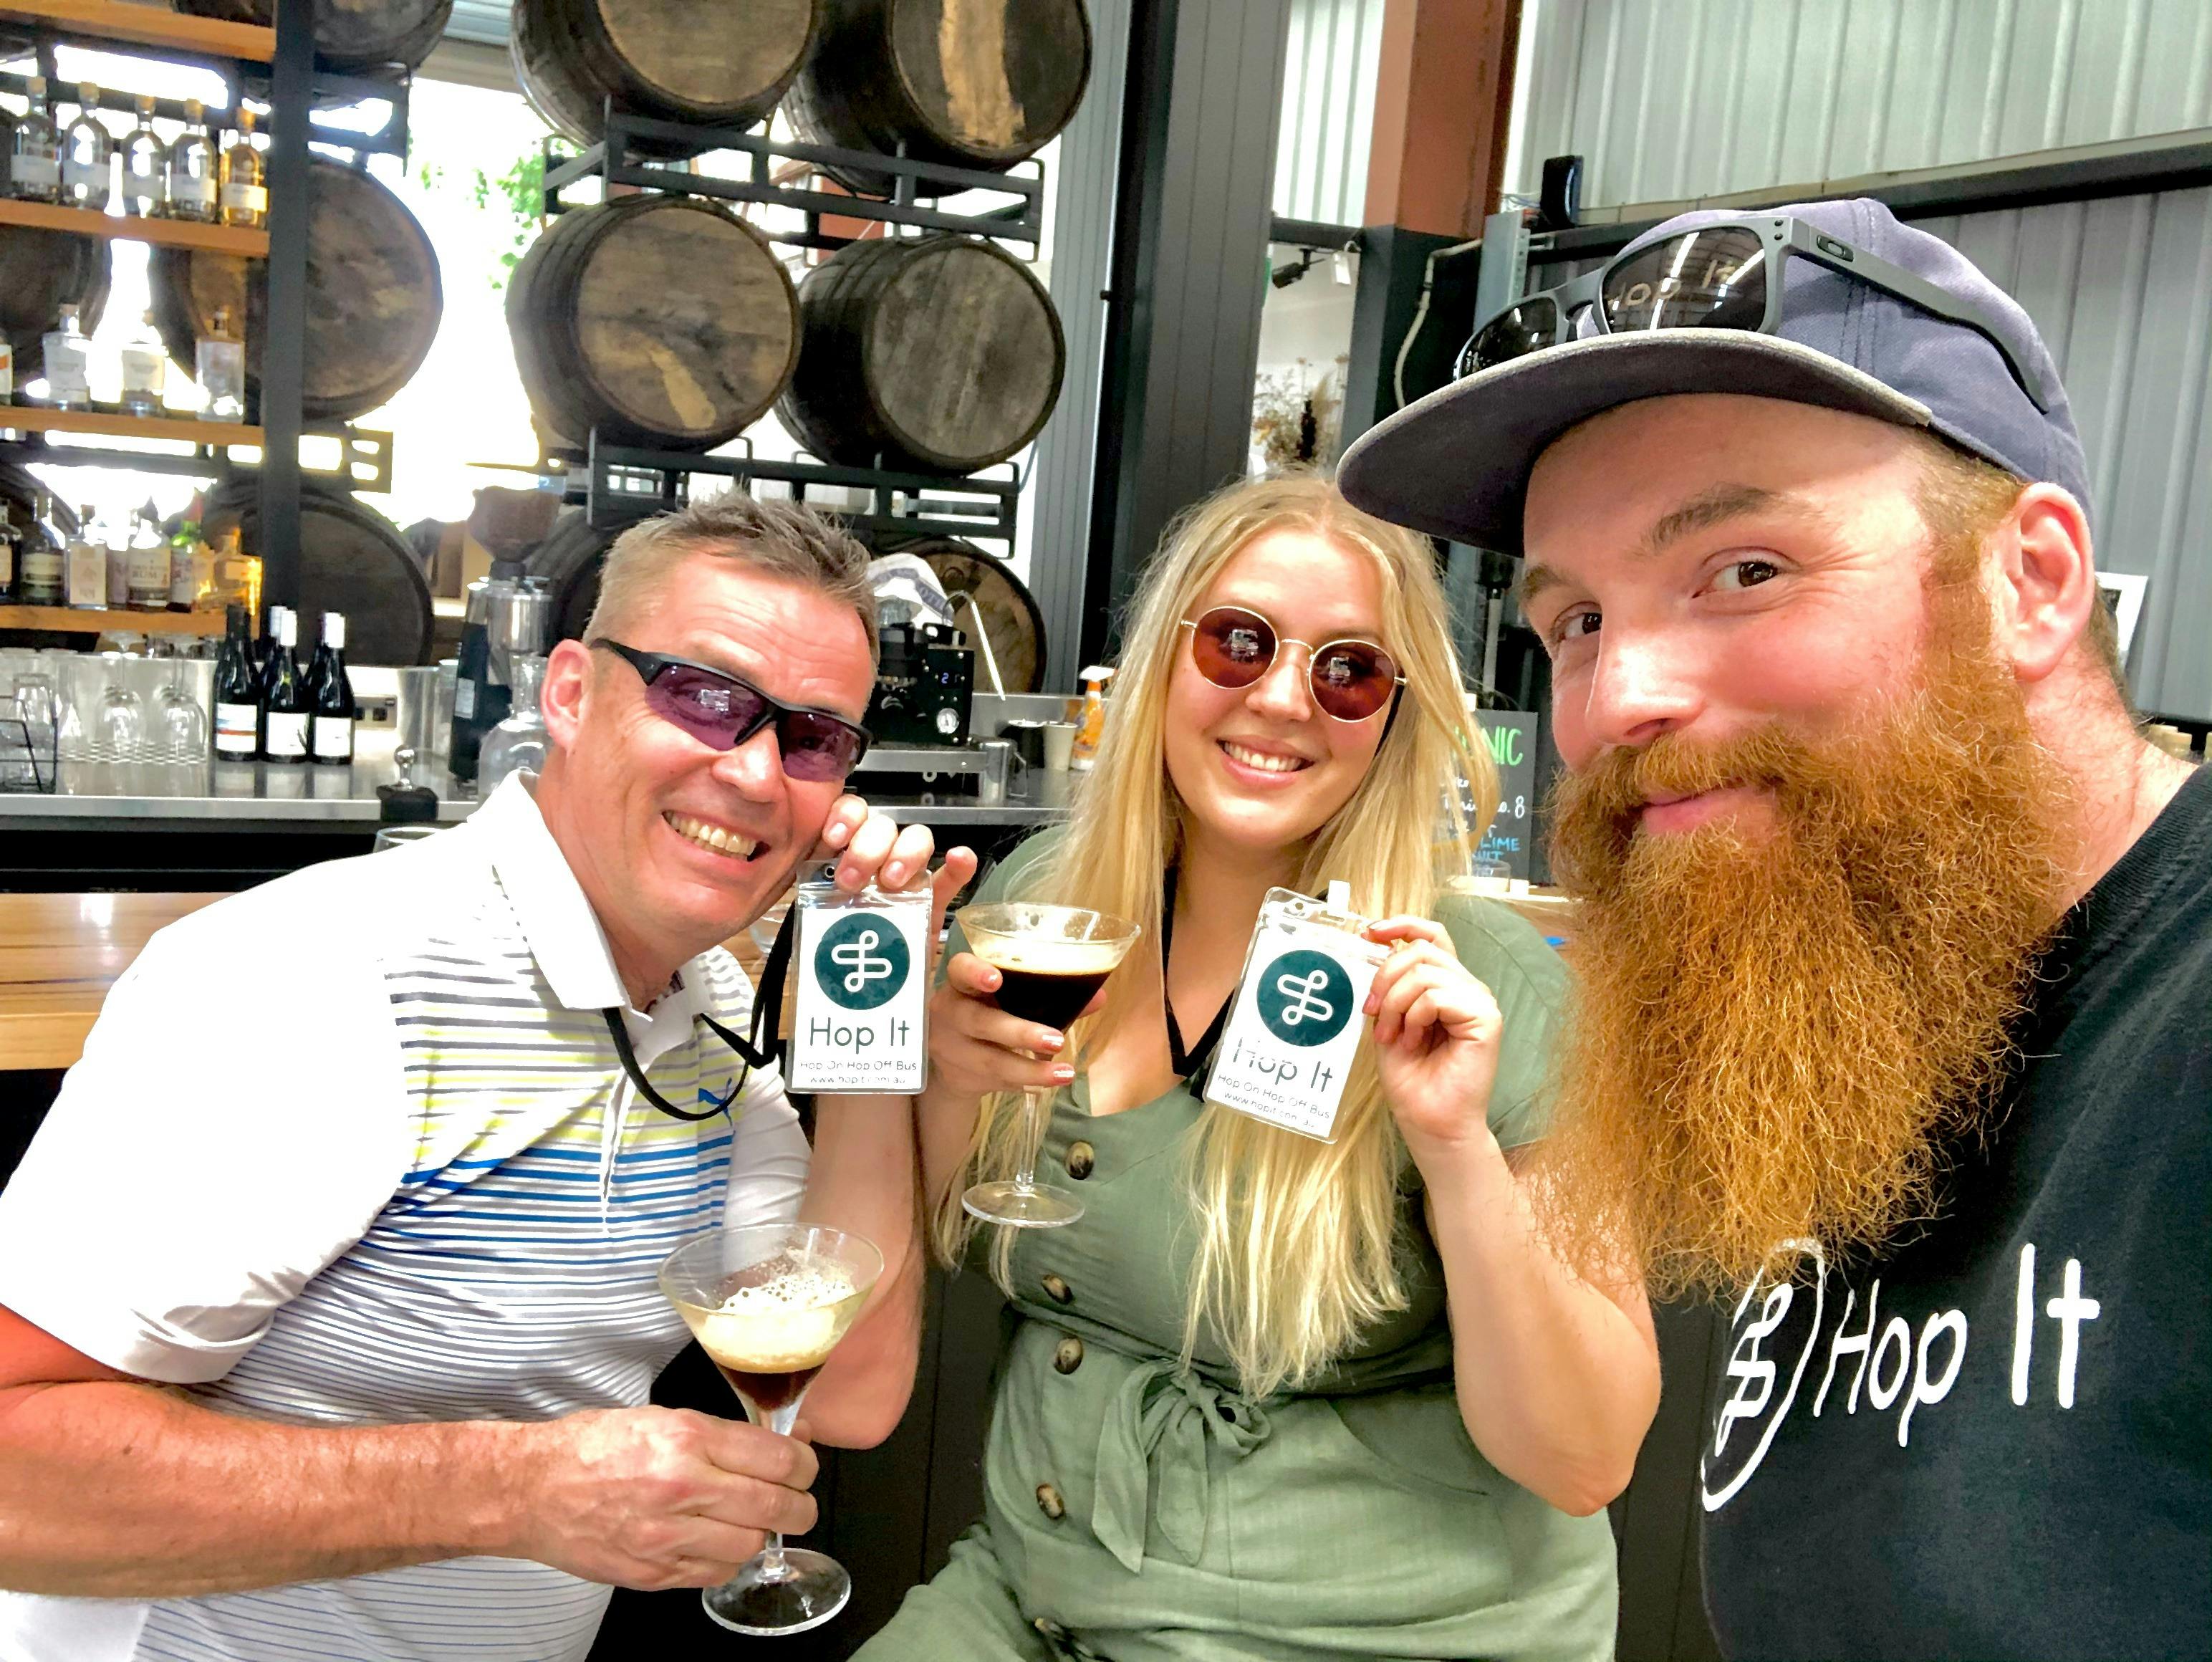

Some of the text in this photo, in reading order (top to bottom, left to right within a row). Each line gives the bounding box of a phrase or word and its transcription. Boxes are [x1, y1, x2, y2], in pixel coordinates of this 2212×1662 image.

[1478, 726, 1524, 766] NIC
[1480, 837, 1521, 852] LIME
[809, 1017, 910, 1055] Hop It
[800, 1060, 917, 1070] Hop On Hop Off Bus
[1232, 1037, 1333, 1092] Hop It
[1218, 1075, 1329, 1119] Hop On Hop Off Bus
[1813, 1242, 2101, 1448] Hop It
